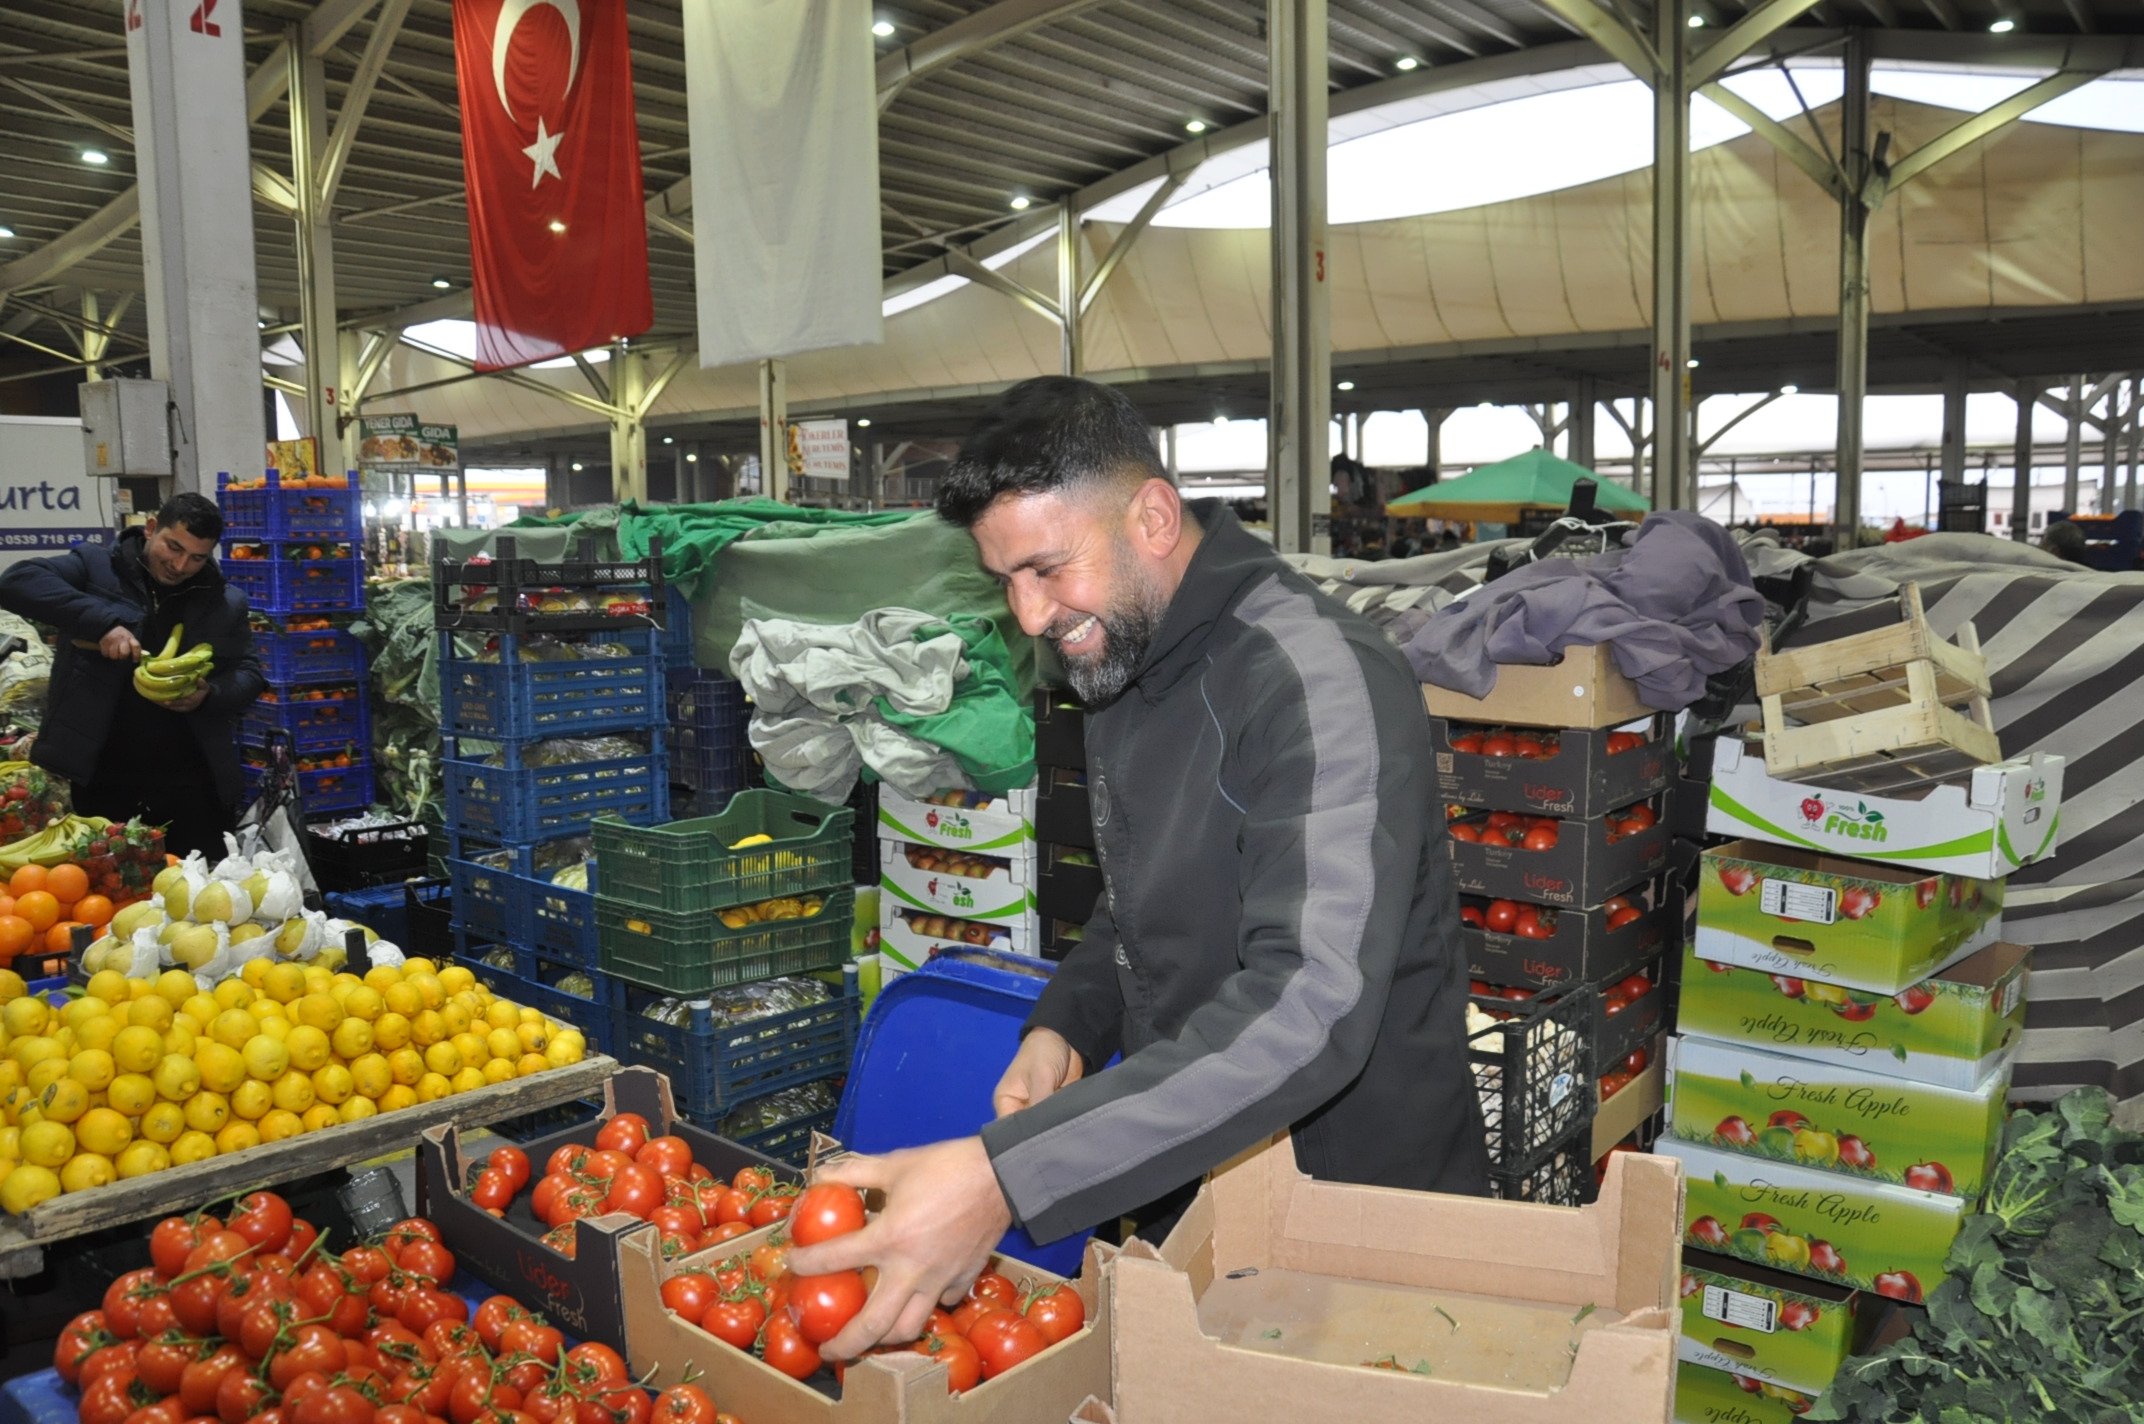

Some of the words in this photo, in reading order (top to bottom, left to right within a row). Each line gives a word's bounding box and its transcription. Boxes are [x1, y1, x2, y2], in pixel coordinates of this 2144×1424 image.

[1315, 250, 1325, 282] 3
[325, 387, 335, 405] 3
[392, 416, 414, 429] GIDA
[421, 426, 451, 440] GIDA
[0, 480, 81, 511] urta
[5, 535, 37, 545] 0539
[41, 535, 65, 545] 718
[87, 534, 102, 545] 48
[1524, 783, 1566, 802] Lider
[1542, 799, 1574, 814] Fresh
[940, 823, 973, 839] Fresh
[1824, 815, 1888, 843] Fresh
[1524, 871, 1565, 891] Lider
[1542, 888, 1574, 903] Fresh
[1523, 958, 1564, 977] Lider
[1751, 951, 1790, 969] Apple
[1793, 959, 1838, 978] Fresh
[1739, 1014, 1800, 1043] Apple
[1807, 1026, 1878, 1056] Fresh
[1766, 1075, 1838, 1105] Fresh
[1843, 1088, 1912, 1120] Apple
[1740, 1178, 1809, 1210] Fresh
[1815, 1193, 1882, 1226] Apple
[516, 1248, 571, 1301] Lider
[546, 1292, 588, 1333] Fresh
[1694, 1350, 1731, 1370] Apple
[1734, 1361, 1778, 1380] Fresh
[1703, 1406, 1764, 1424] pple
